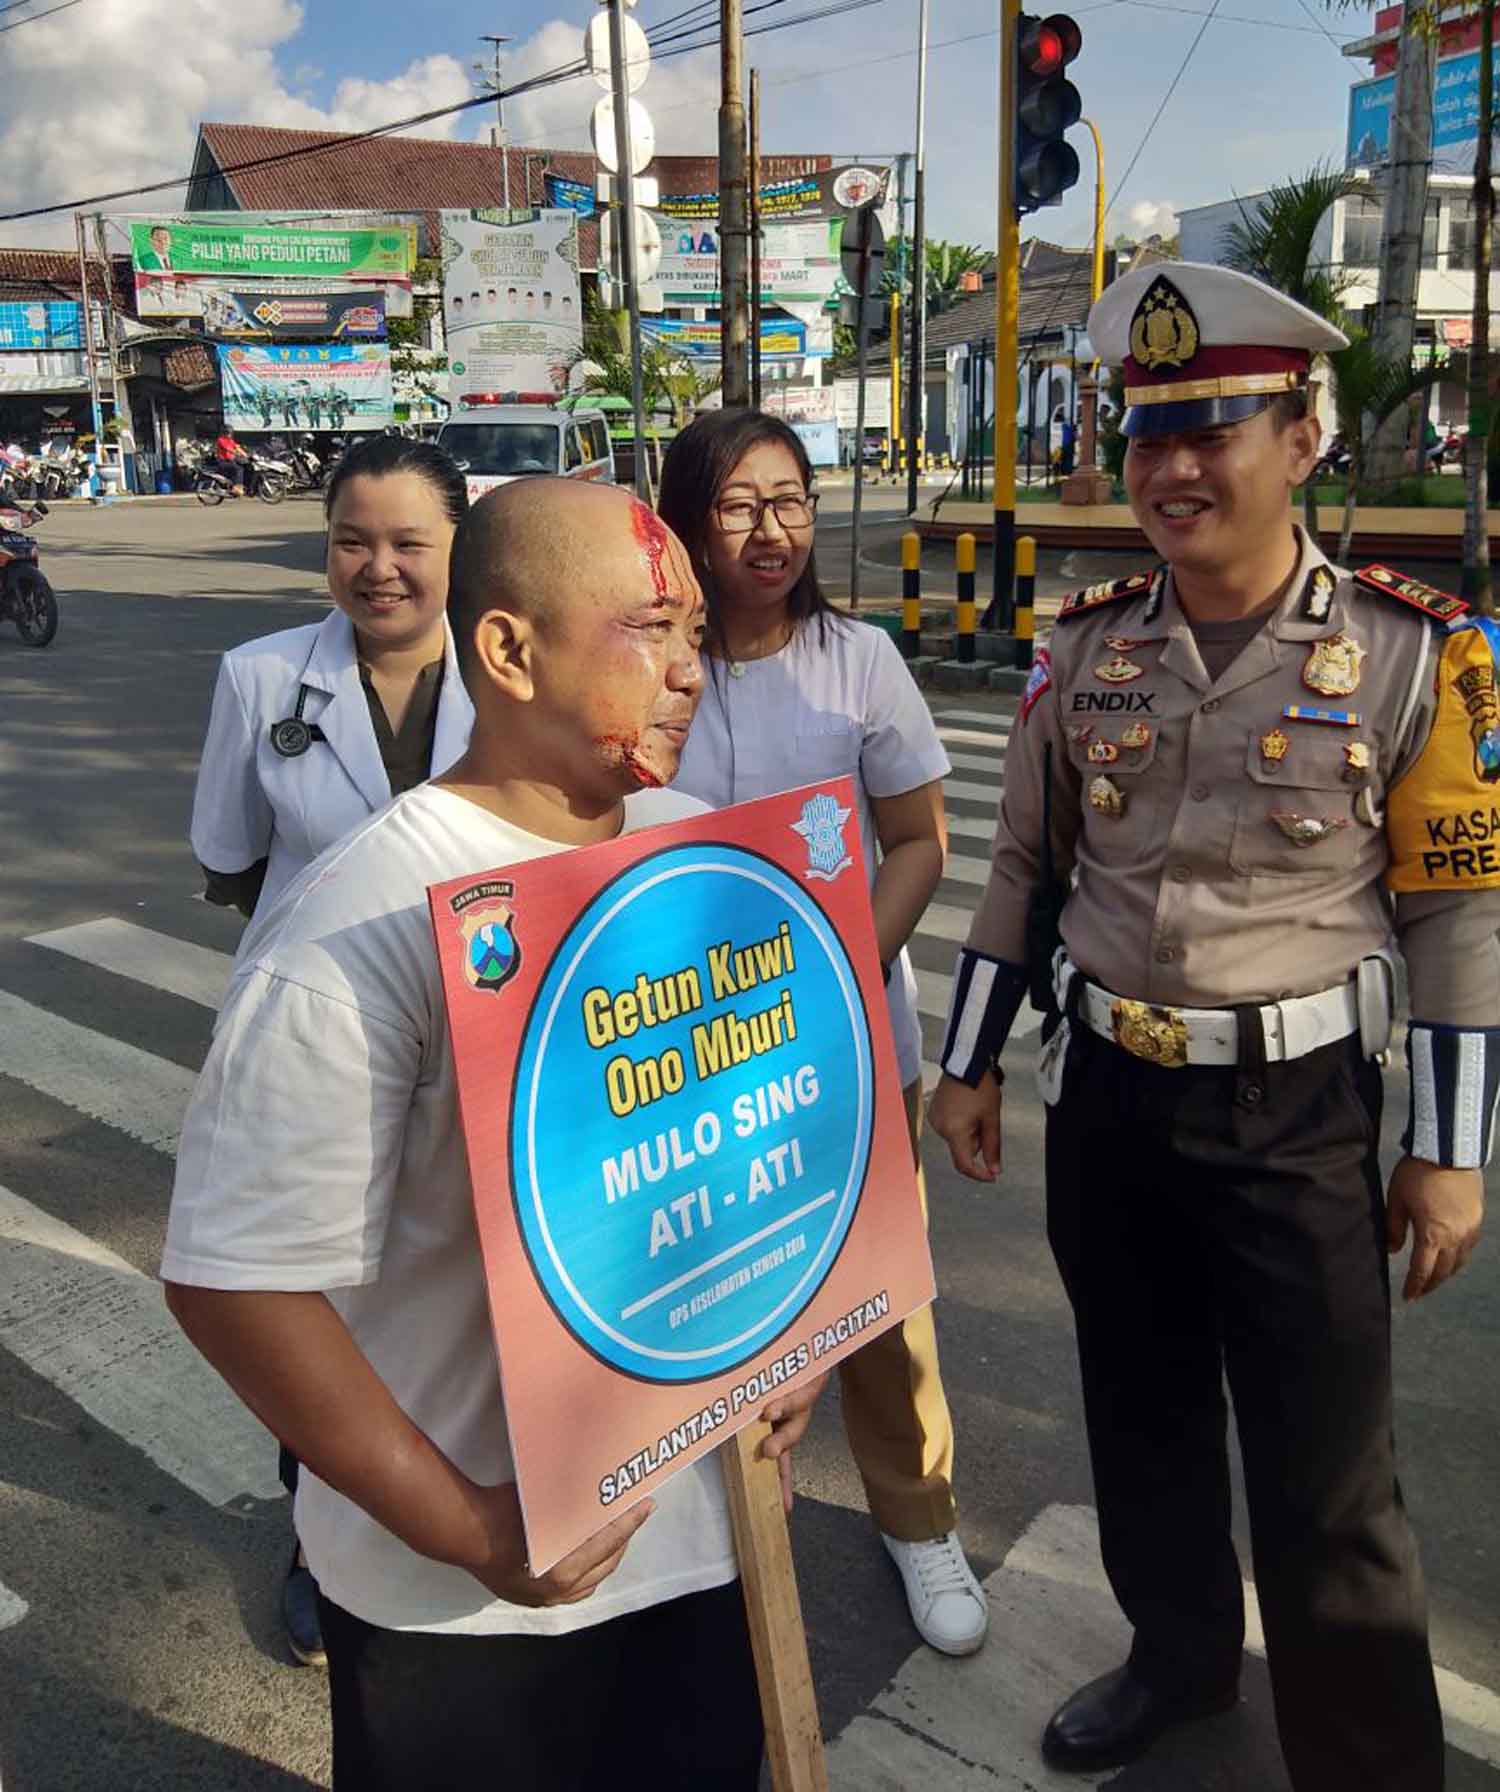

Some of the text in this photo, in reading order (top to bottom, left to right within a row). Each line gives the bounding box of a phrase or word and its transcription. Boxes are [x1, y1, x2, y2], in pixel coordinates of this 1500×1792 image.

[1072, 691, 1155, 713] ENDIX
[454, 884, 510, 911] JAWA TIMUR
[582, 920, 796, 1050] Getun Kuwi
[605, 989, 797, 1118] Ono Mburi
[602, 1064, 820, 1205] MULO SING
[648, 1185, 713, 1258] ATI
[747, 1138, 804, 1203] ATI
[599, 1290, 890, 1506] SATLANTAS POLRES PACITAN
